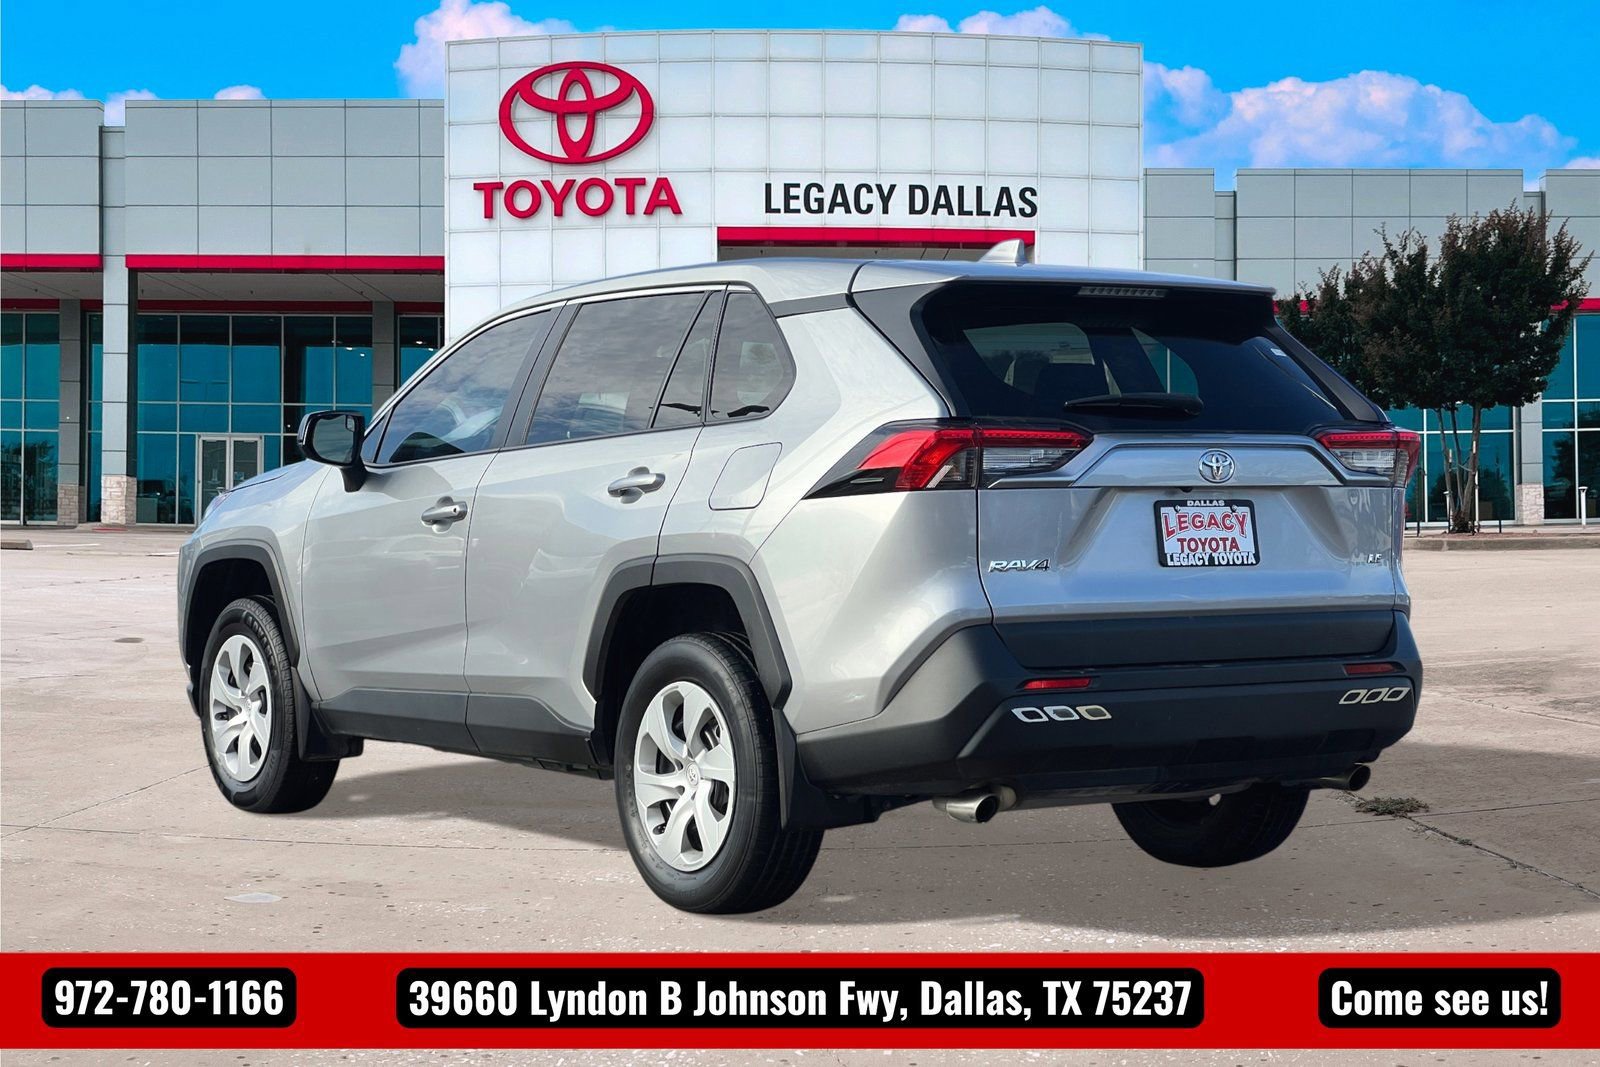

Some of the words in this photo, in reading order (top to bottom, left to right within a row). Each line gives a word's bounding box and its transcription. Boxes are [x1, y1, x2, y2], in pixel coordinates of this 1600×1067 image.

[473, 177, 682, 219] TOYOTA
[764, 182, 897, 215] LEGACY
[908, 184, 1038, 218] DALLAS
[1162, 512, 1248, 541] LEGACY
[1177, 537, 1240, 553] TOYOTA
[988, 558, 1051, 573] RAV4
[1167, 553, 1210, 566] LEGACY
[1212, 553, 1256, 565] TOYOTA
